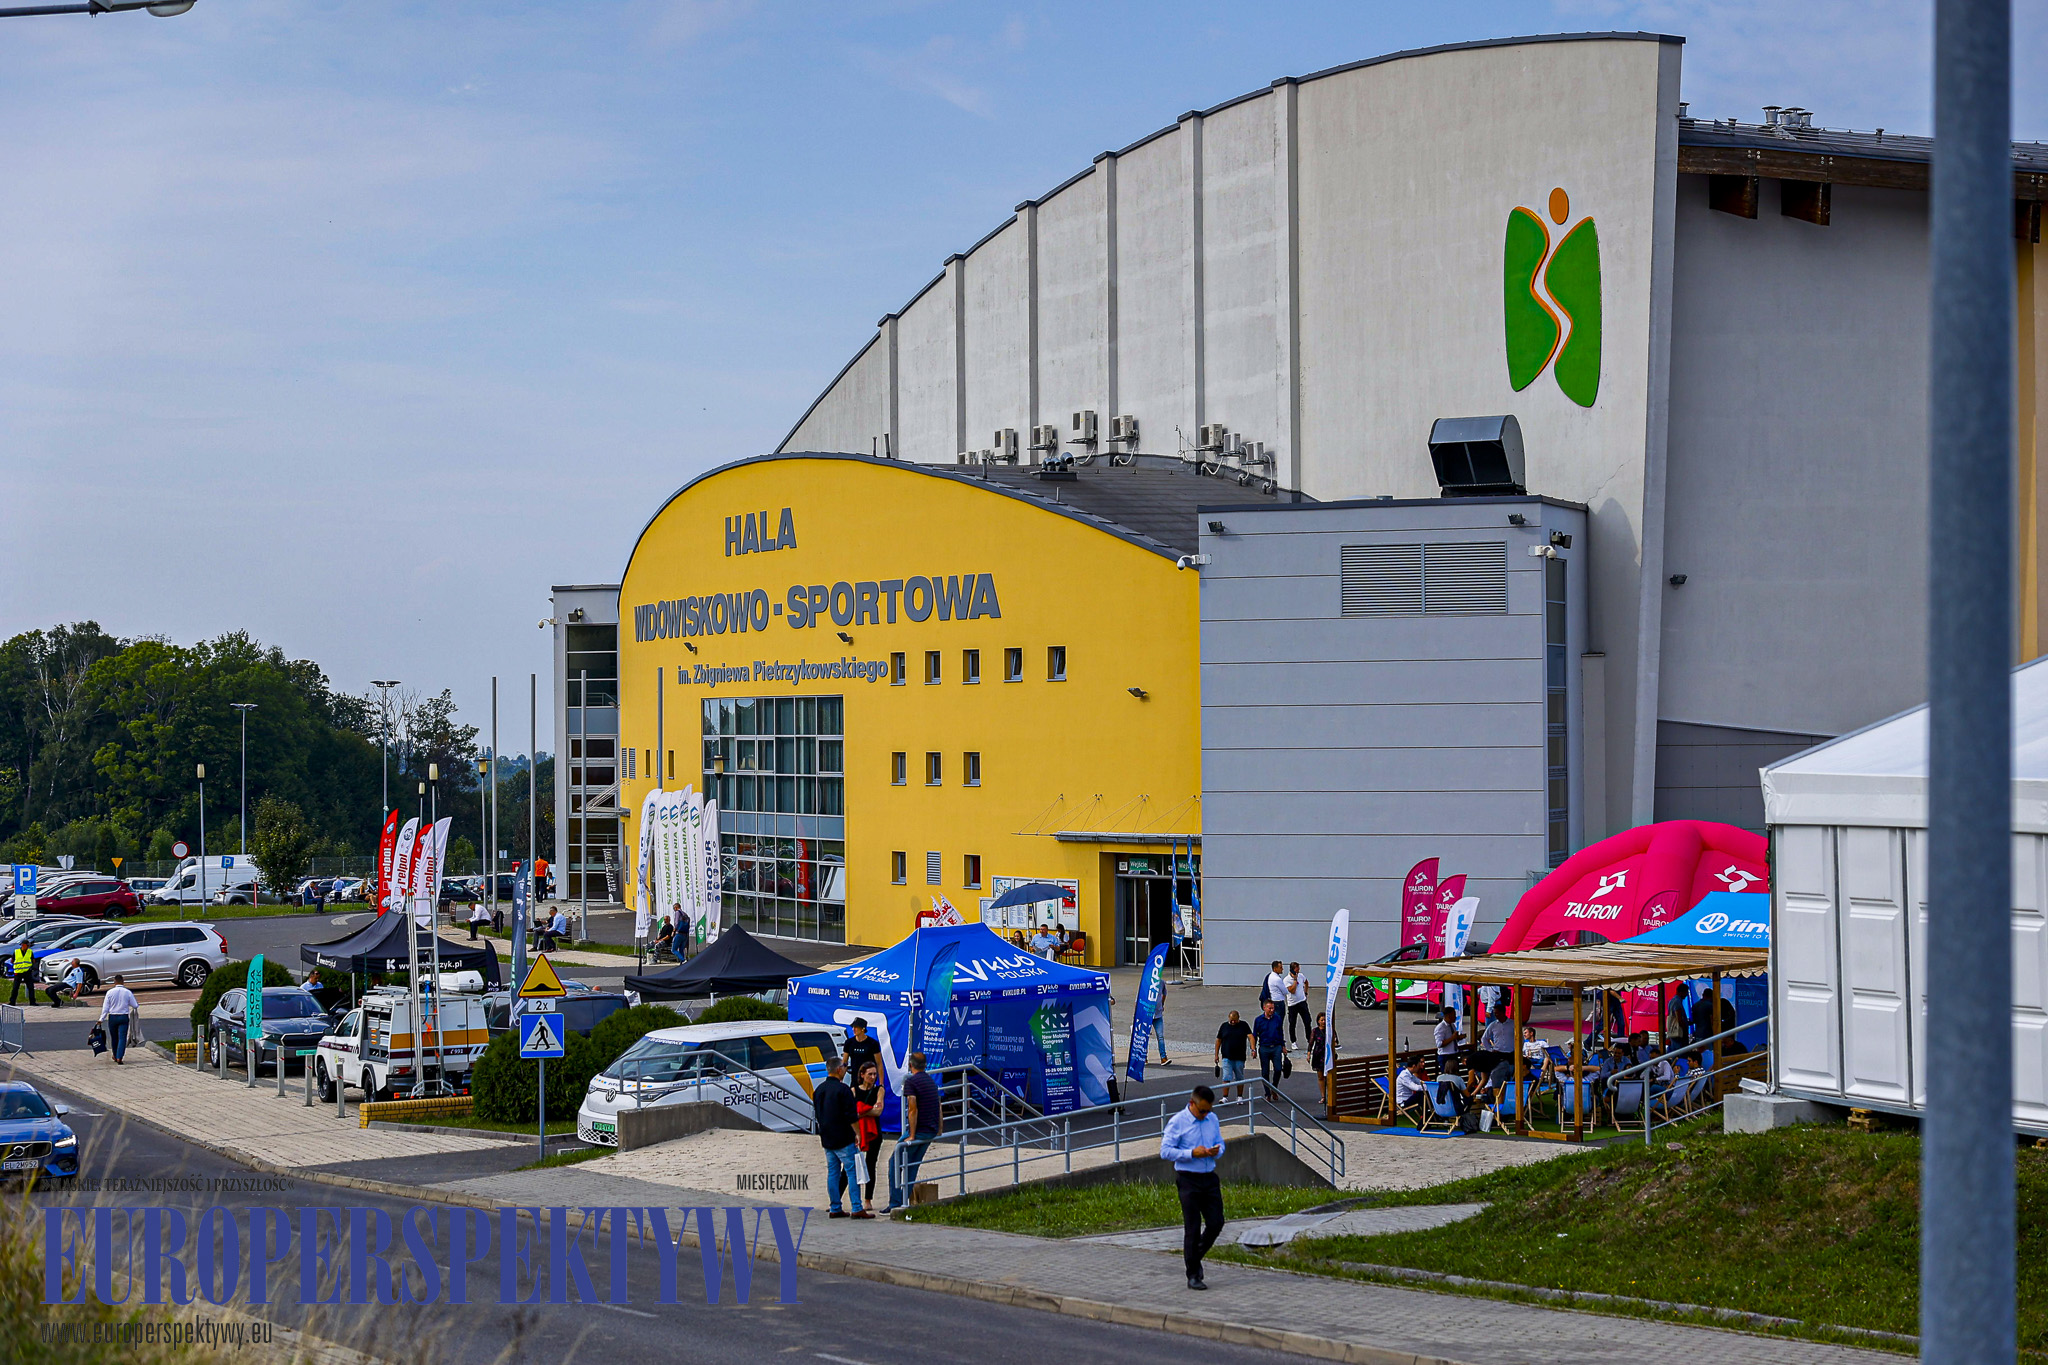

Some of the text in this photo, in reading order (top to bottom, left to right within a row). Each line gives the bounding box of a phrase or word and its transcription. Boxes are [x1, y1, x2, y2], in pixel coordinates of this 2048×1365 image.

[725, 507, 796, 557] HALA
[634, 588, 769, 642] WIDOWISKOWO
[787, 573, 1002, 629] SPORTOWA
[678, 656, 888, 686] im. Zbigniewa Pietrzykowskiego
[397, 853, 408, 885] relpol
[663, 832, 673, 905] SZYNDZIELNIA
[1408, 885, 1434, 893] TAURON
[1563, 902, 1623, 920] TAURON
[980, 953, 1036, 971] klub
[868, 966, 900, 980] klub
[996, 967, 1048, 980] POLSKA
[1148, 954, 1164, 1003] EXPO
[535, 1001, 548, 1011] 2x
[729, 1084, 743, 1094] EV
[723, 1090, 790, 1107] EXPERIENCE
